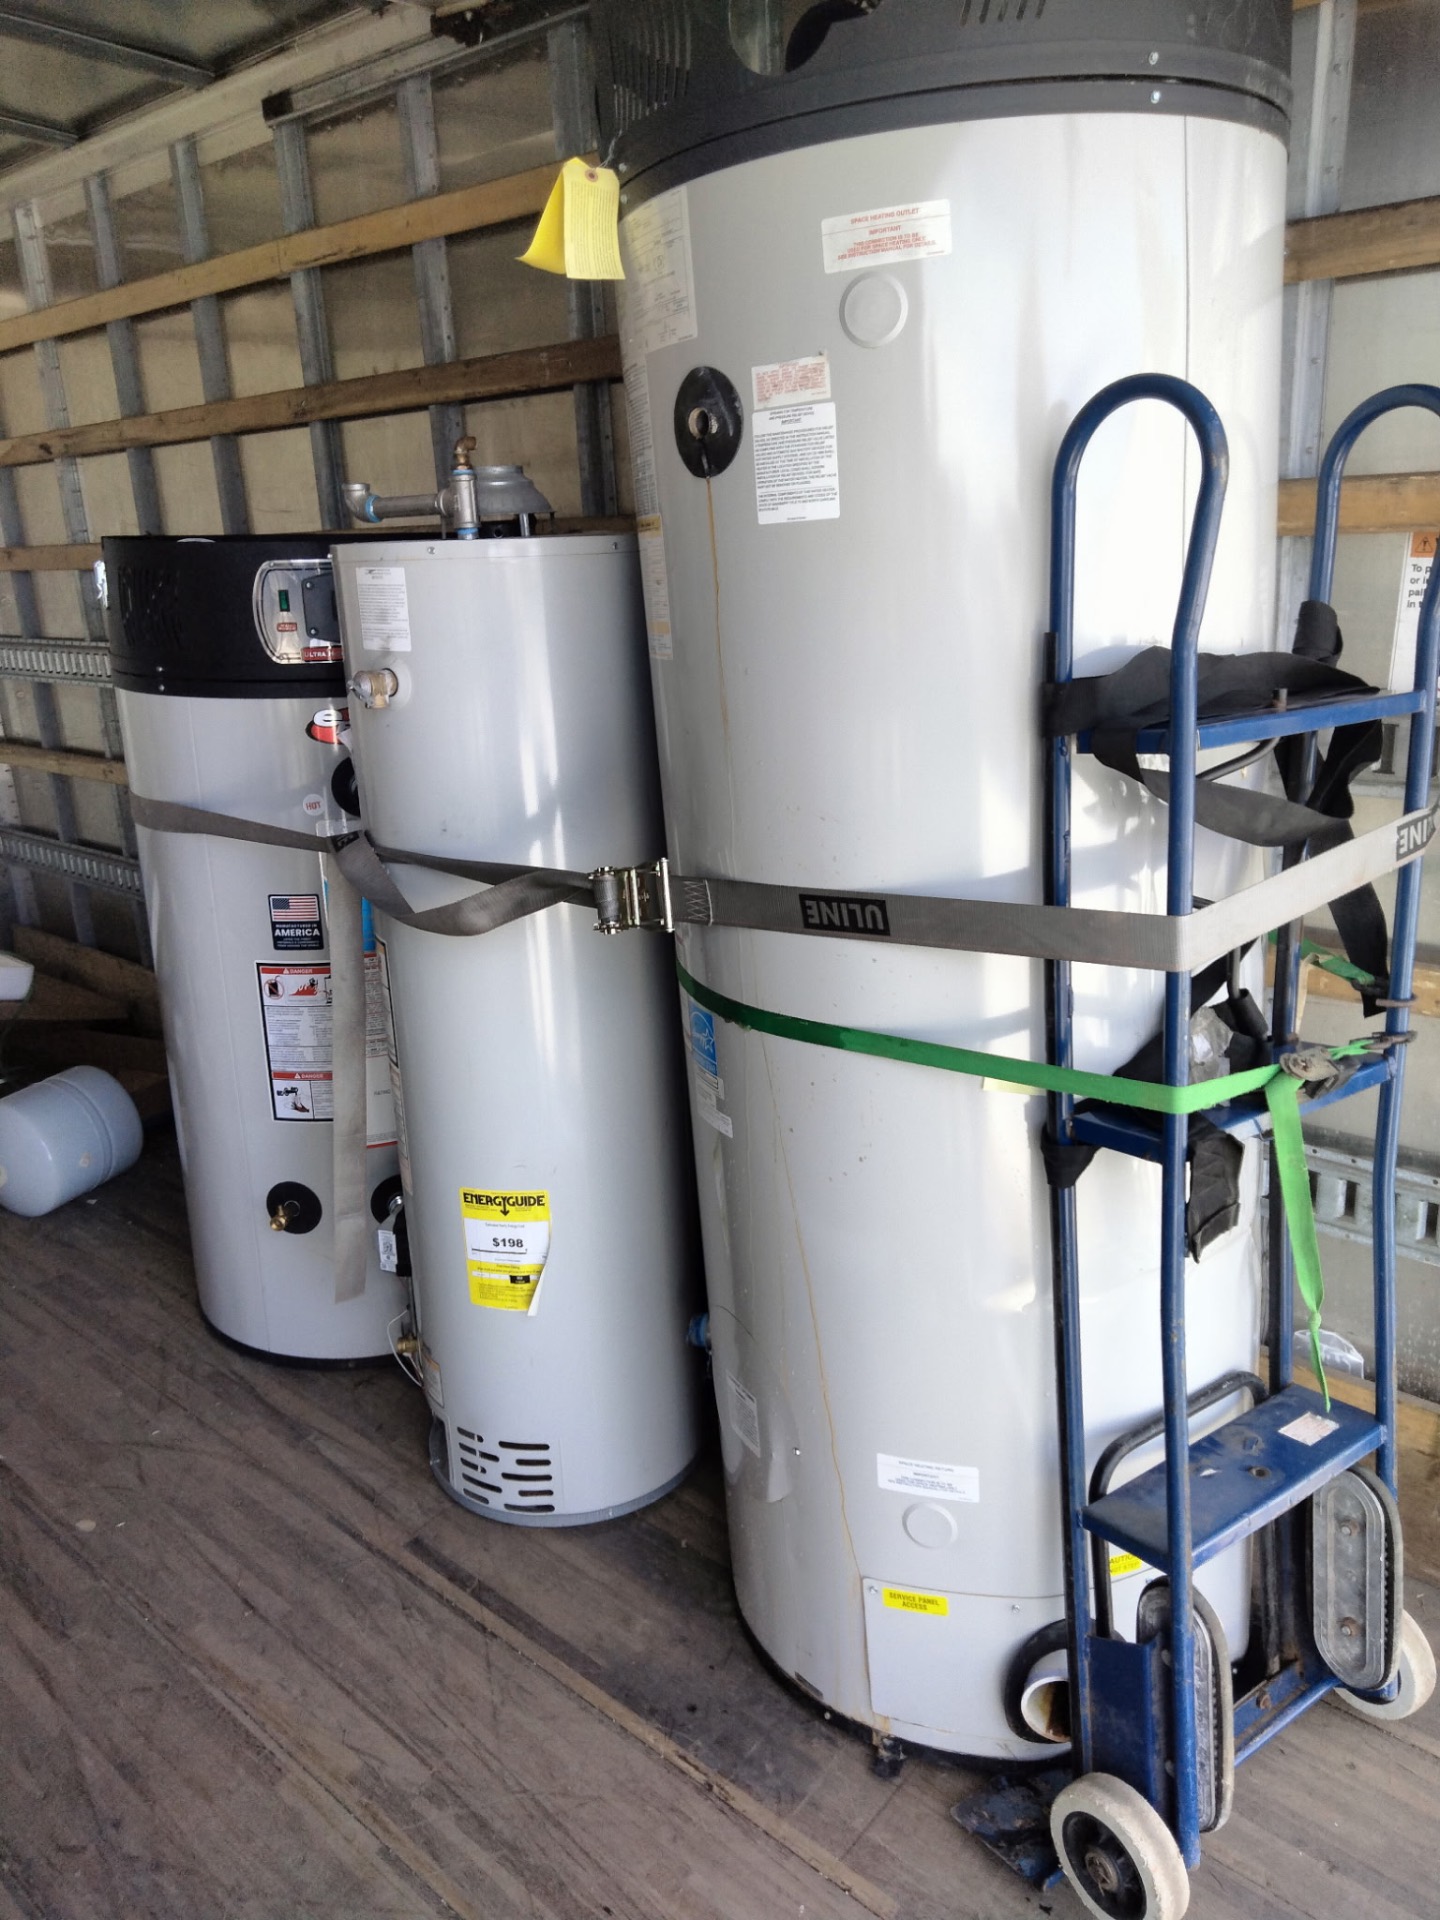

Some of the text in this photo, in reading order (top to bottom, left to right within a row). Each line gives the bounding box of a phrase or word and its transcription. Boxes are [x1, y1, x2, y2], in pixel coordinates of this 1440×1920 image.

[850, 207, 919, 224] SPACE HEATING OUTLET
[868, 225, 902, 235] IMPORTANT
[1411, 563, 1423, 572] To
[1406, 599, 1416, 608] in
[305, 801, 321, 810] HOT
[1399, 817, 1428, 854] INE
[805, 900, 884, 930] ULINE
[274, 928, 320, 937] AMERICA
[463, 1191, 546, 1207] ENERGYGUIDE
[492, 1237, 524, 1248] $198
[889, 1592, 940, 1606] SERVICE PANEL
[902, 1601, 928, 1611] ACCESS
